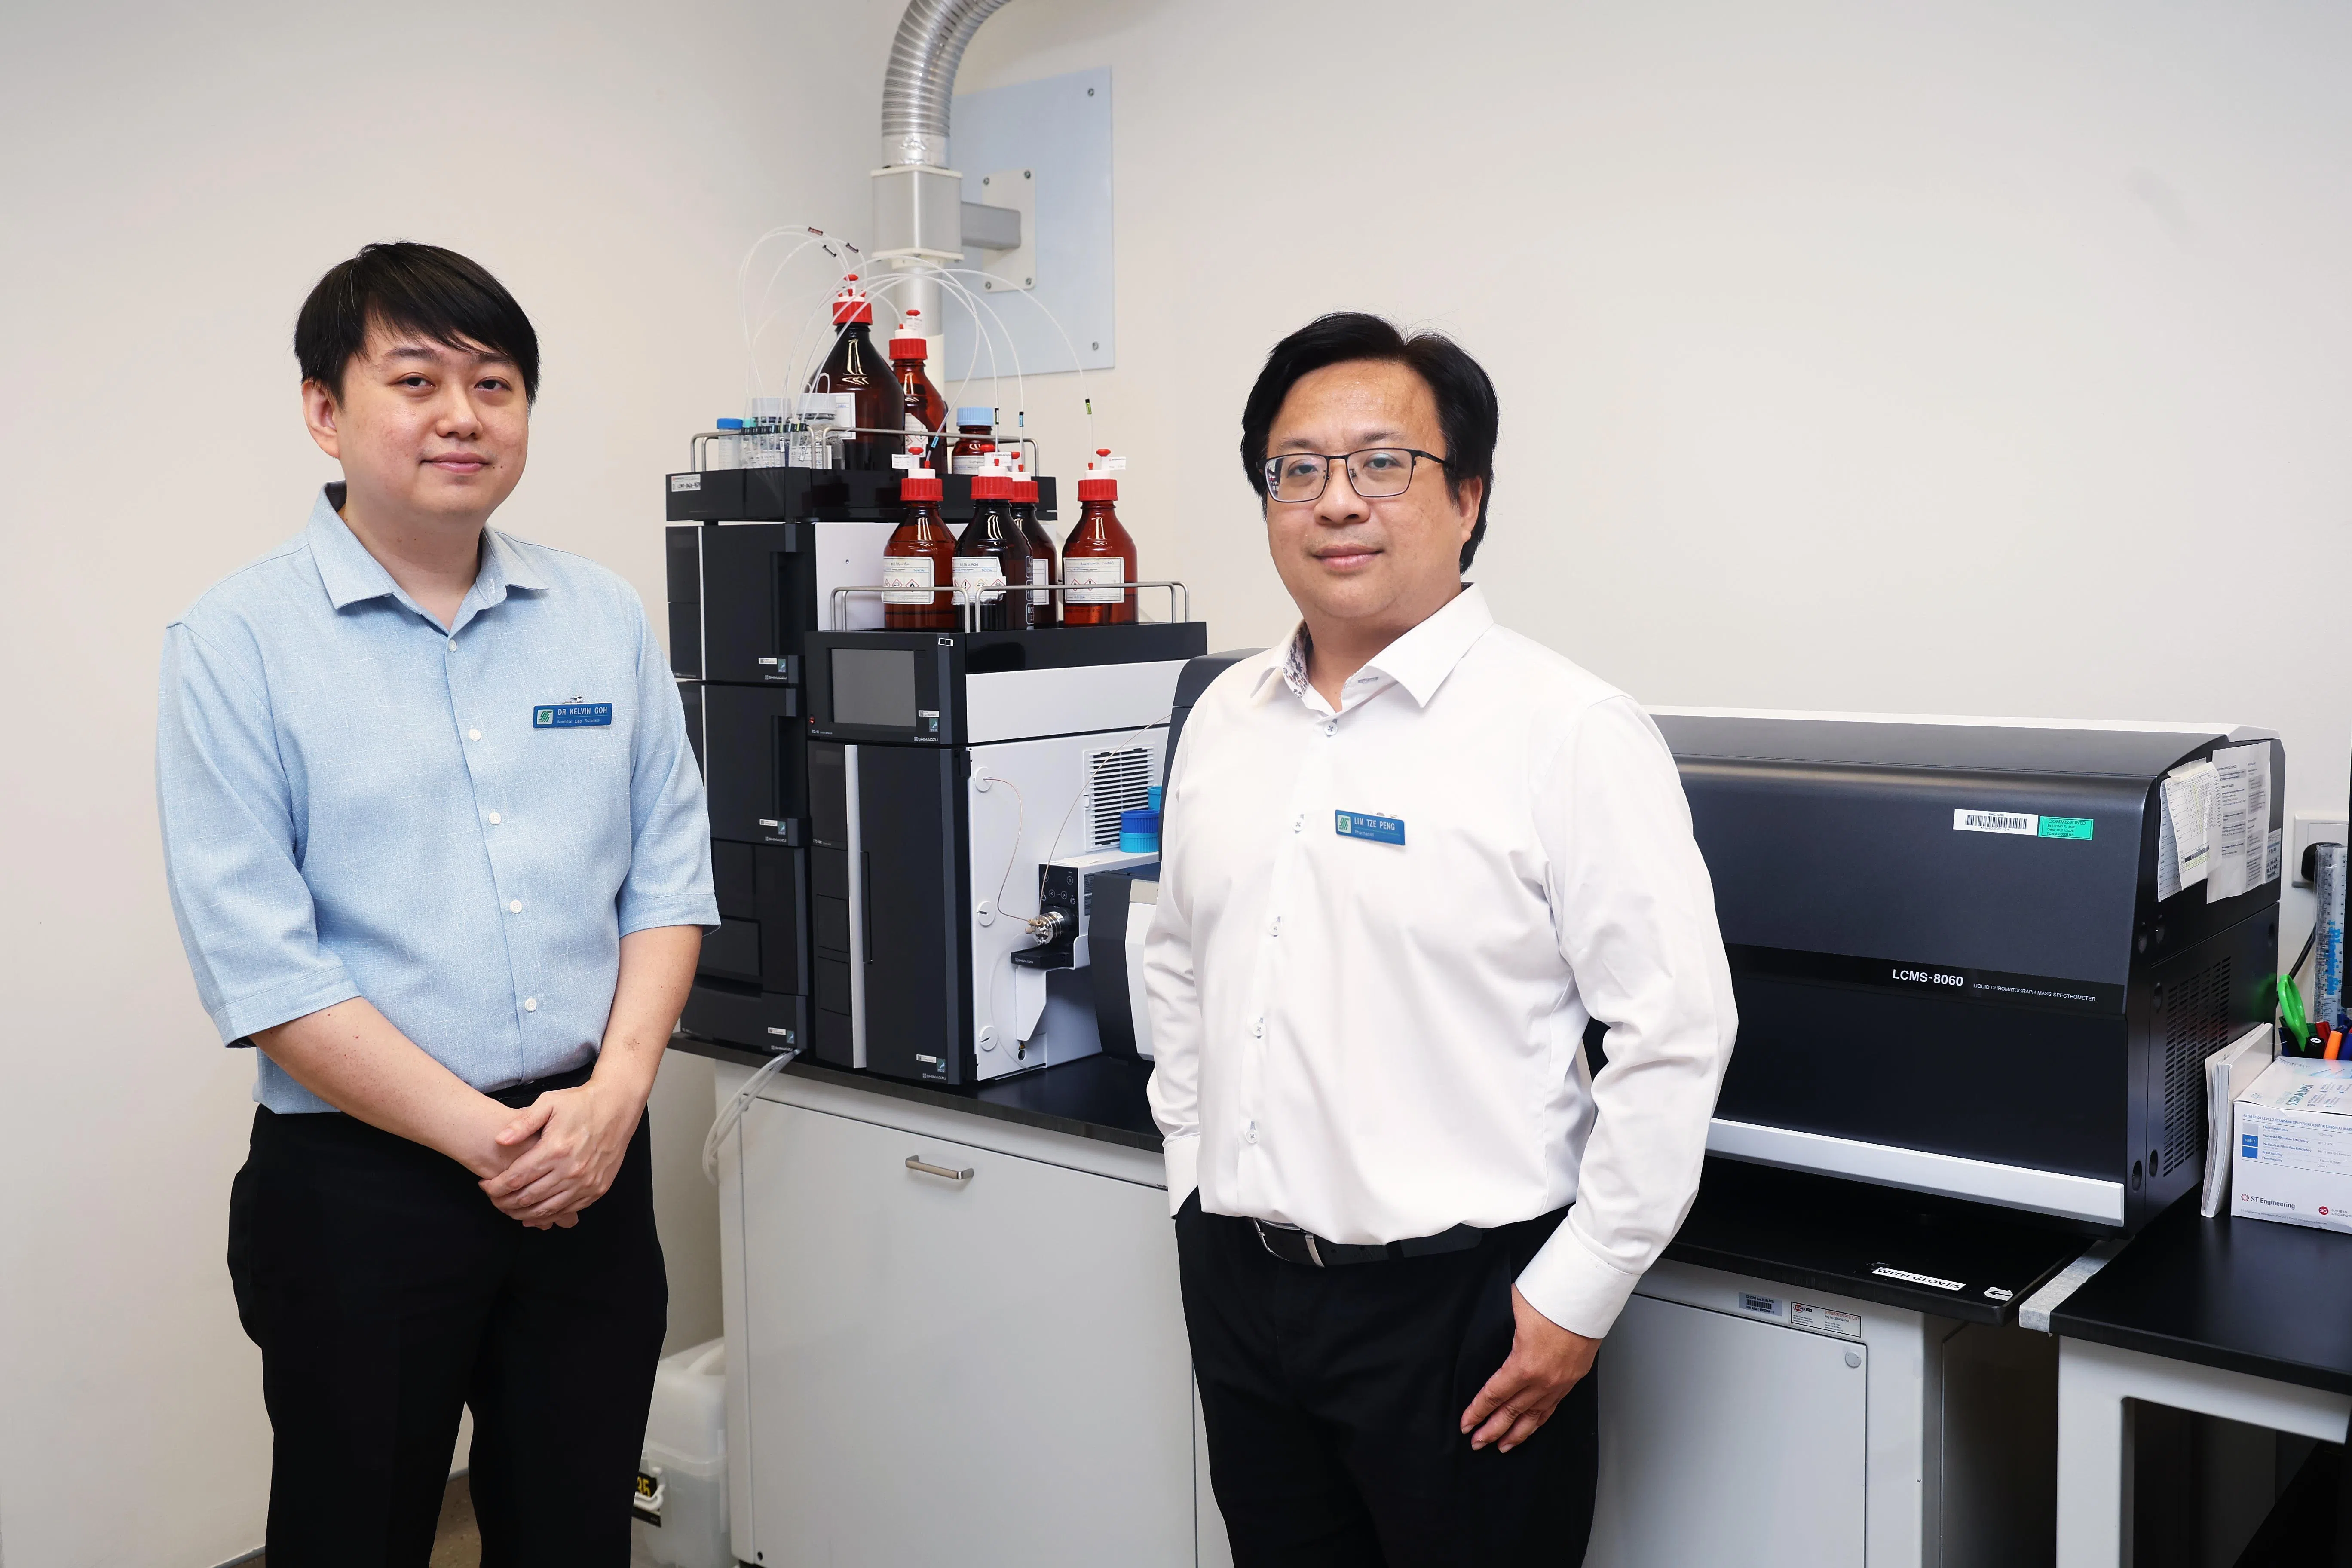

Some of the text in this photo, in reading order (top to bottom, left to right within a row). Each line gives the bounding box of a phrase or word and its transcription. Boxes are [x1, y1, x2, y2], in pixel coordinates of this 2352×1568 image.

[1354, 817, 1395, 830] LIM TZE PENG
[1893, 969, 1963, 986] LCMS-8060
[1991, 986, 2036, 995] CHROMATOGRAPH
[2053, 992, 2096, 1001] SPECTROMETER
[2297, 1084, 2314, 1092] MASK
[2260, 1197, 2295, 1210] Engineering
[1878, 1269, 1961, 1289] WITH GLOVES
